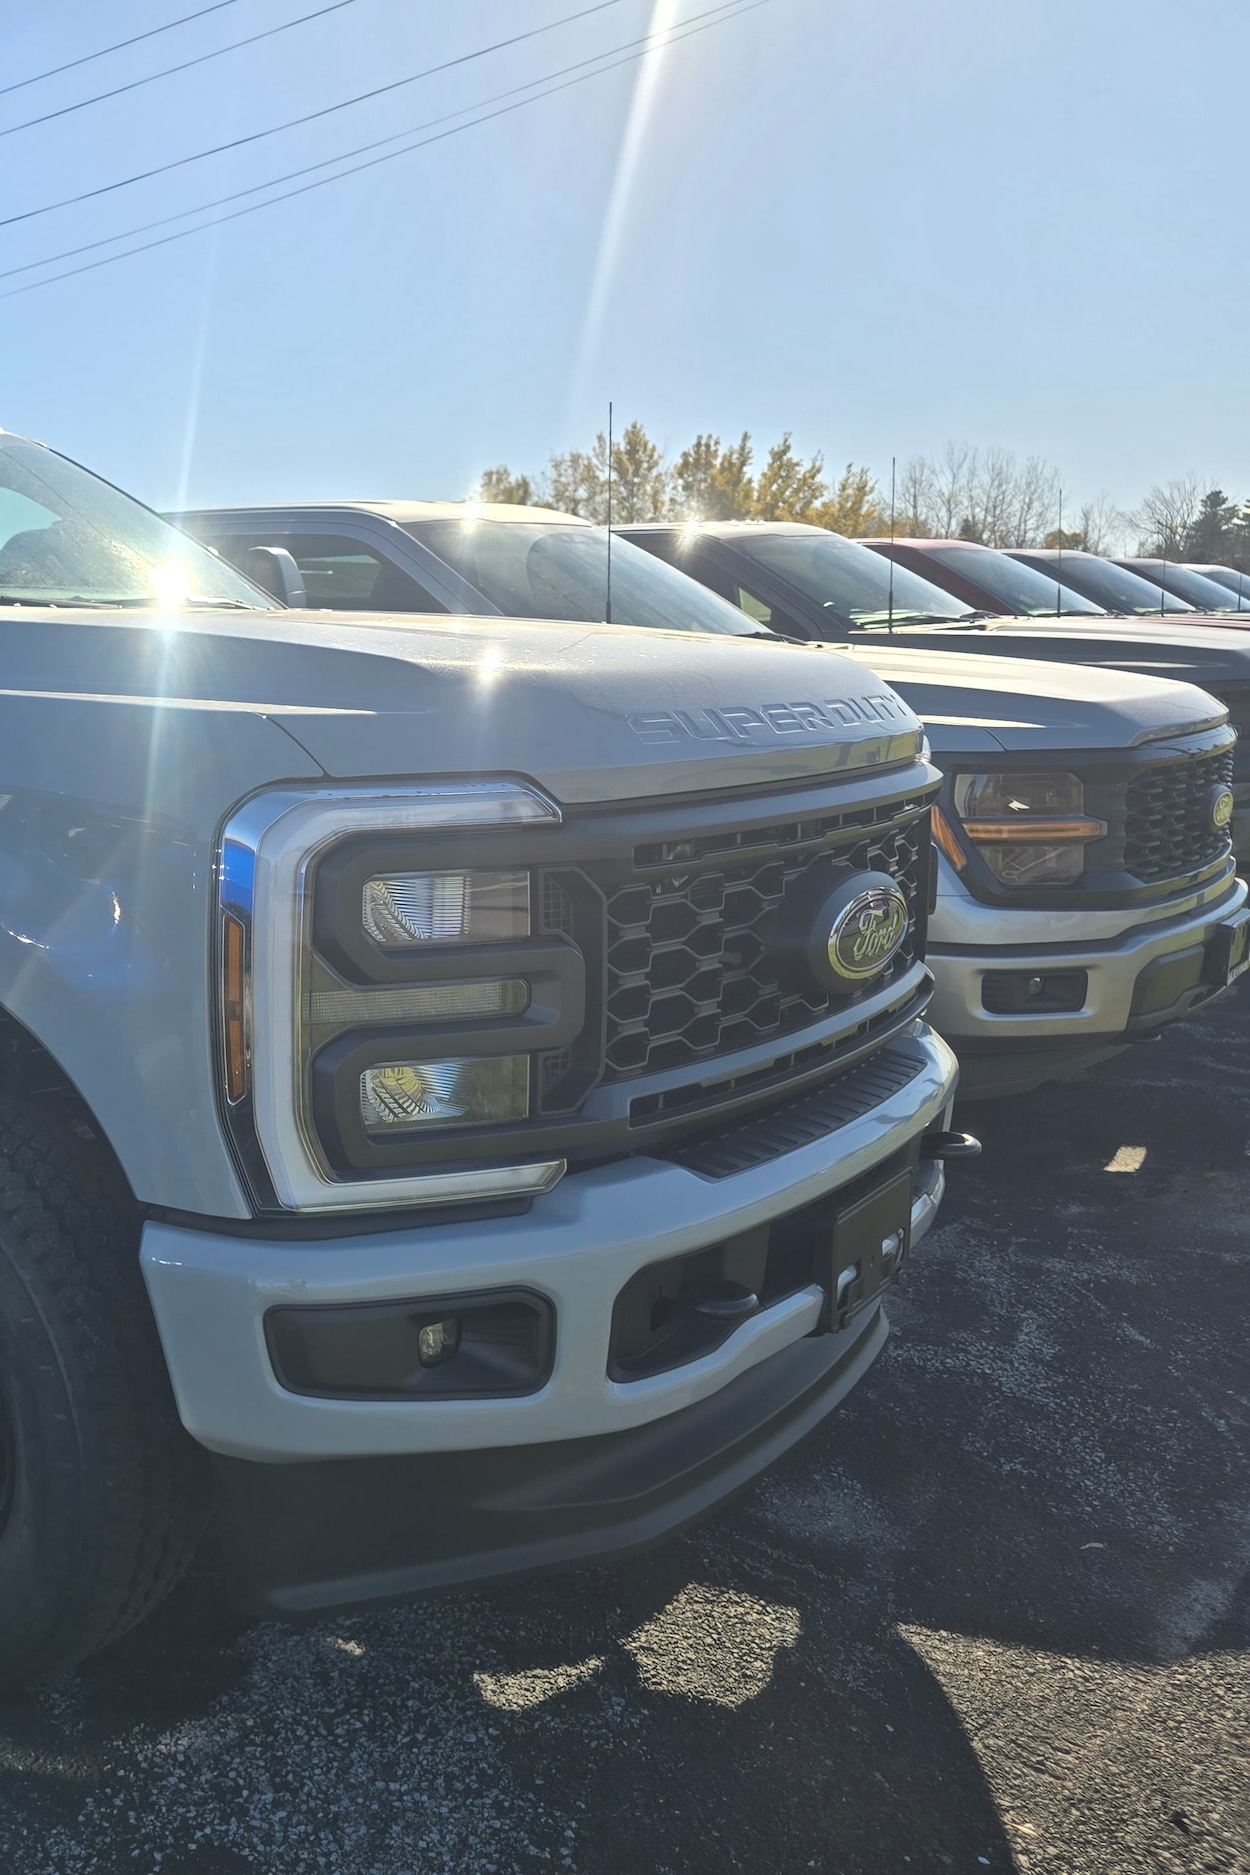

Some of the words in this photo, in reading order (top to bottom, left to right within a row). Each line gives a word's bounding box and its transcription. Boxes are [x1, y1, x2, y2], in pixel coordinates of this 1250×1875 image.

[626, 702, 834, 745] SUPER
[822, 694, 907, 727] DUTY
[853, 905, 898, 961] Ford
